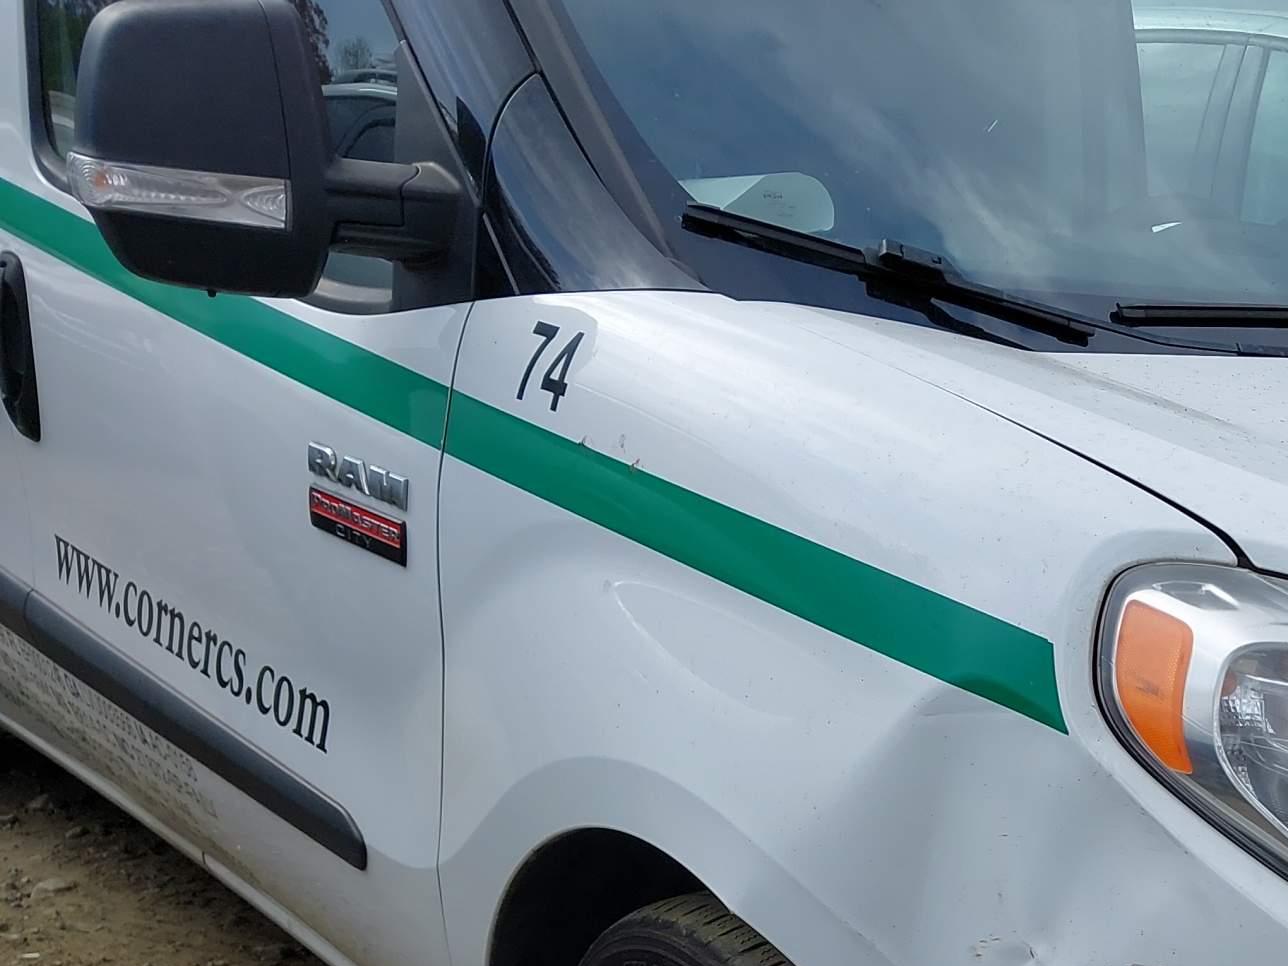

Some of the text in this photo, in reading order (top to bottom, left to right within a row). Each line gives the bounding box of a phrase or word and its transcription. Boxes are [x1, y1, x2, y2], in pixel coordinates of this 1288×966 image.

[516, 320, 585, 412] 74
[308, 441, 409, 512] RAM
[336, 523, 373, 549] CITY
[54, 533, 332, 754] www.cornercs.com
